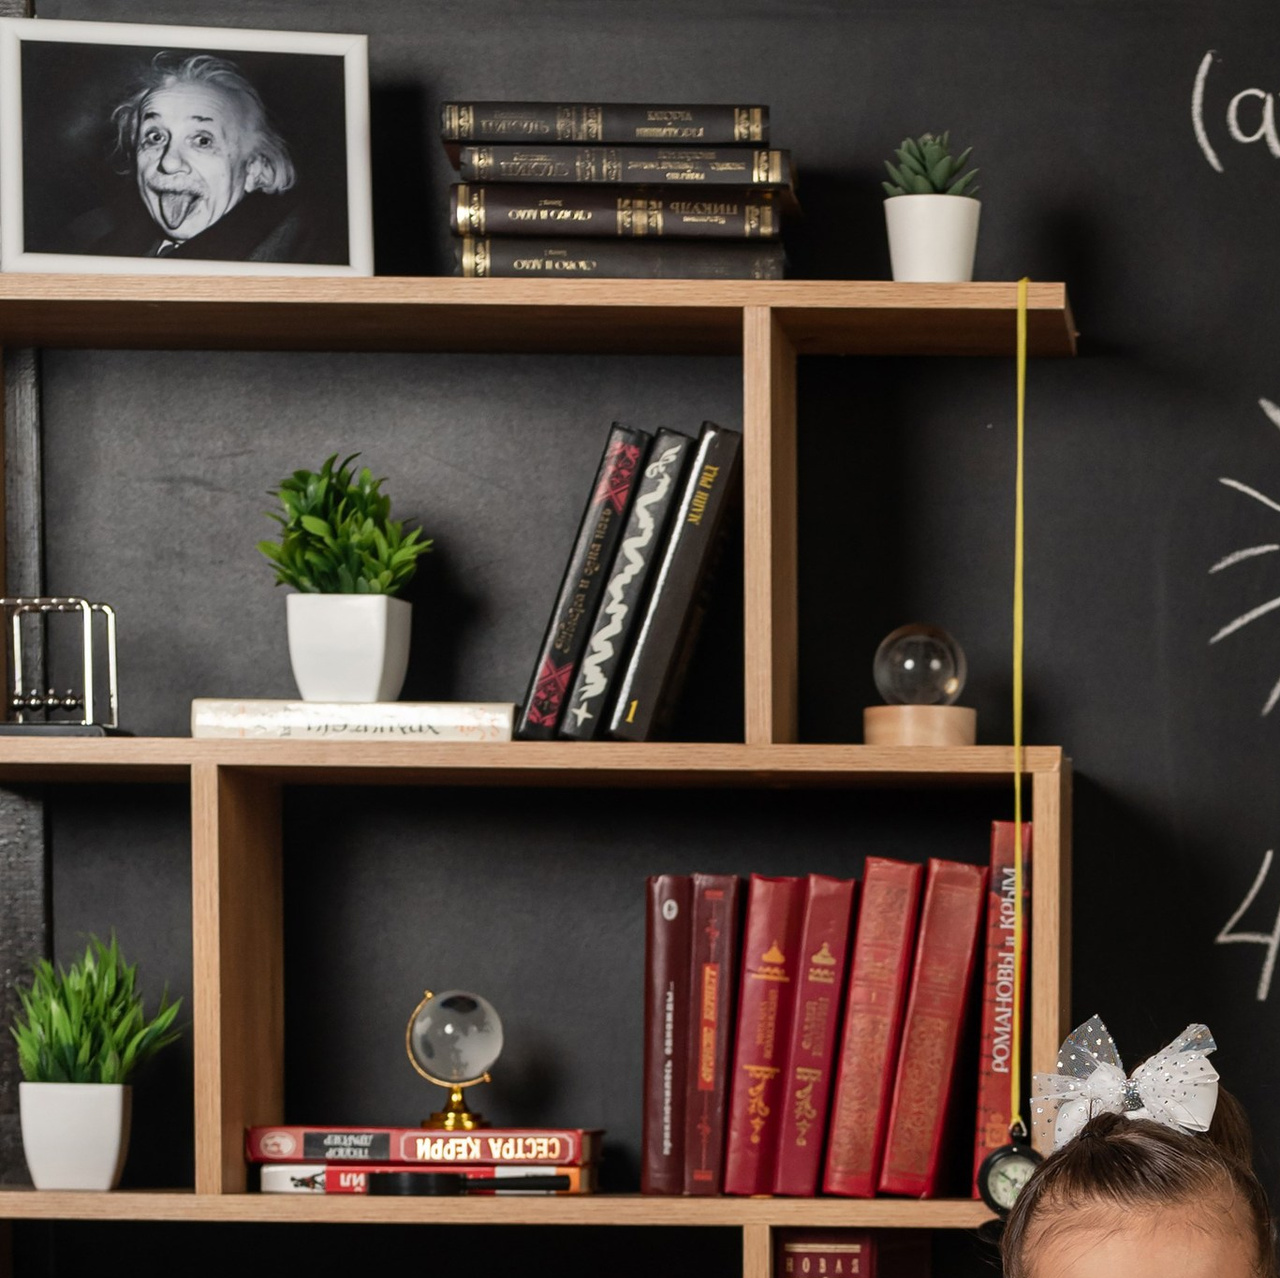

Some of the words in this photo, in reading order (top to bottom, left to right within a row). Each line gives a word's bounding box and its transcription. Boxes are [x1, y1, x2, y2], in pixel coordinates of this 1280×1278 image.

[991, 951, 1016, 1073] РОМАНОВЫ
[415, 1136, 481, 1160] КЕРРИ
[489, 1137, 562, 1160] СЕСТРА
